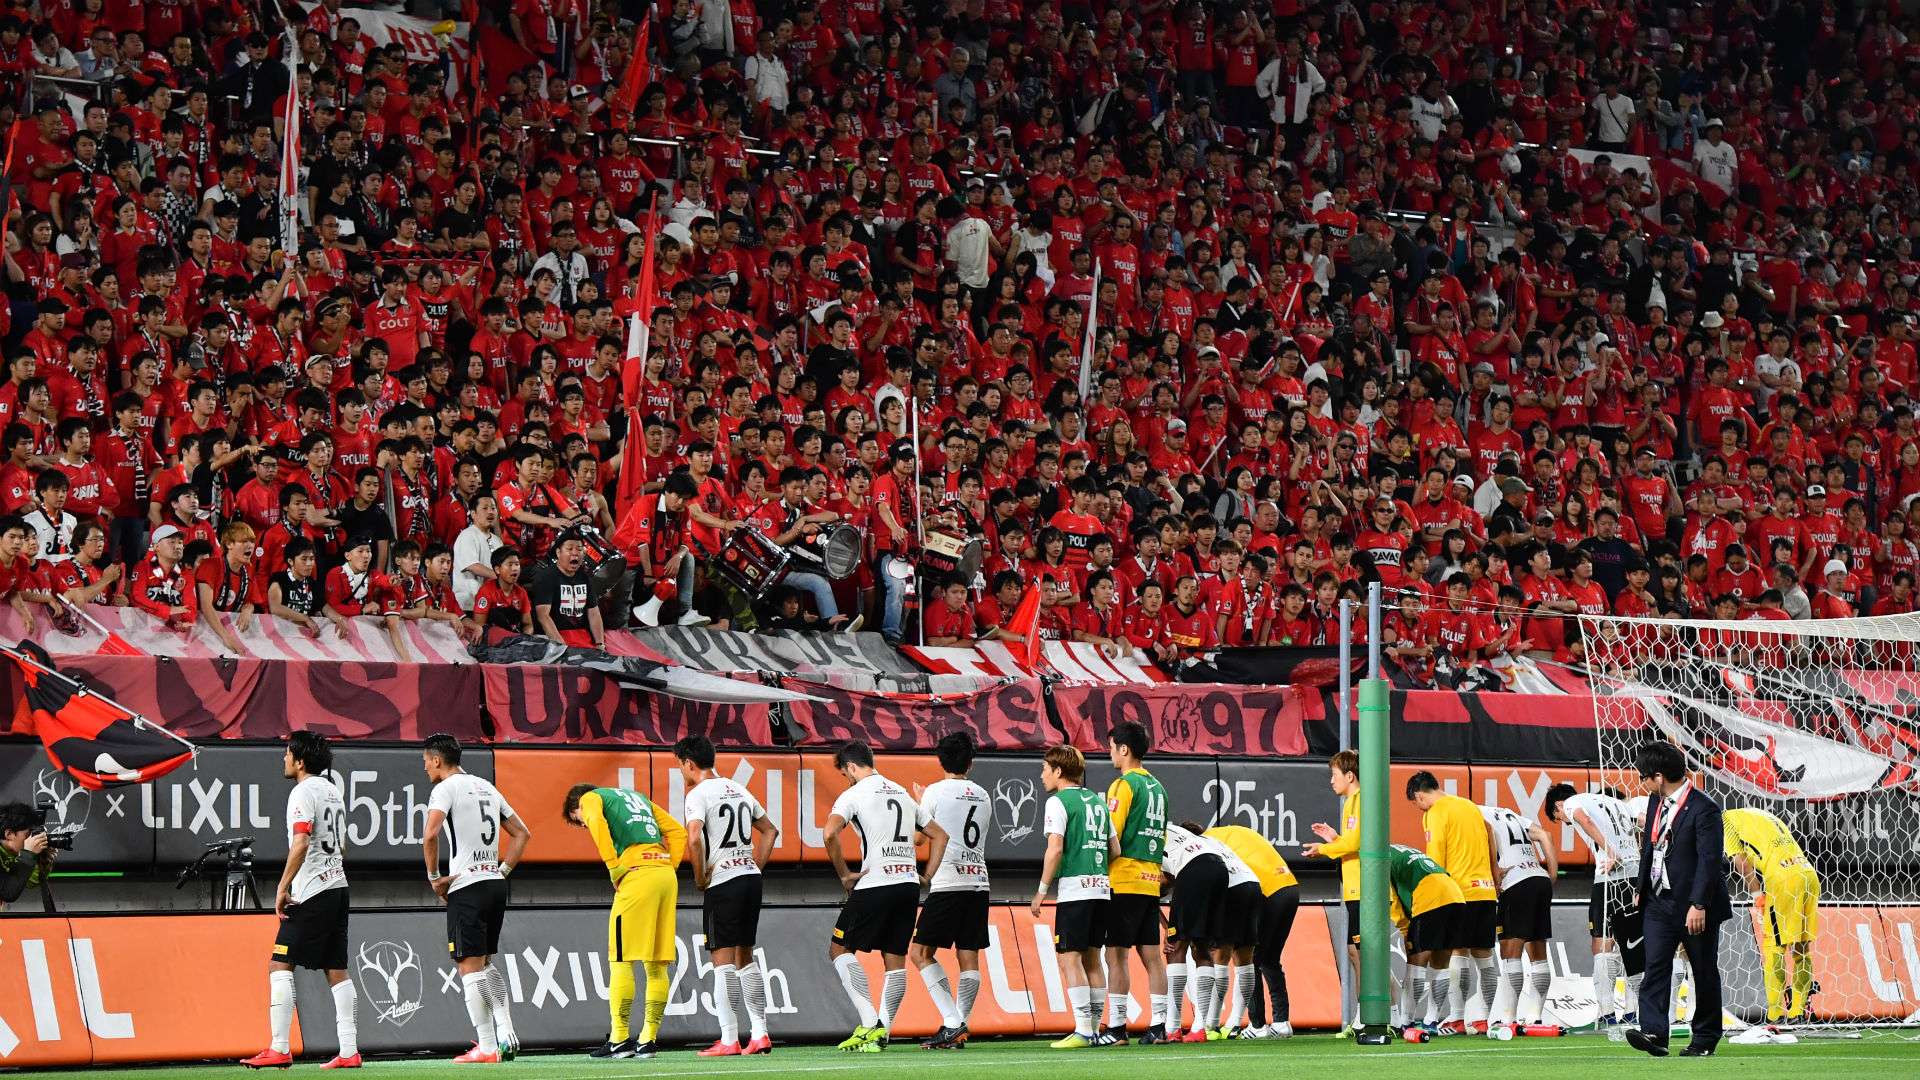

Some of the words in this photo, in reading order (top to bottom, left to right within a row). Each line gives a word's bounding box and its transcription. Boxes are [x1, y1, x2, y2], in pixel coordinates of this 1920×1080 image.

[592, 245, 616, 257] OLUS
[378, 316, 410, 331] COLT
[340, 453, 370, 467] POLUS
[1440, 627, 1466, 644] POLUS
[506, 665, 754, 744] URAWA
[1165, 716, 1190, 738] UB
[141, 777, 270, 836] LIXIL
[479, 799, 496, 846] 5
[718, 801, 752, 849] 20
[887, 798, 909, 843] 2
[963, 805, 981, 849] 6
[1085, 803, 1108, 840] 42
[1145, 791, 1166, 829] 44
[1202, 779, 1300, 847] 25th
[504, 945, 611, 1010] IXIL
